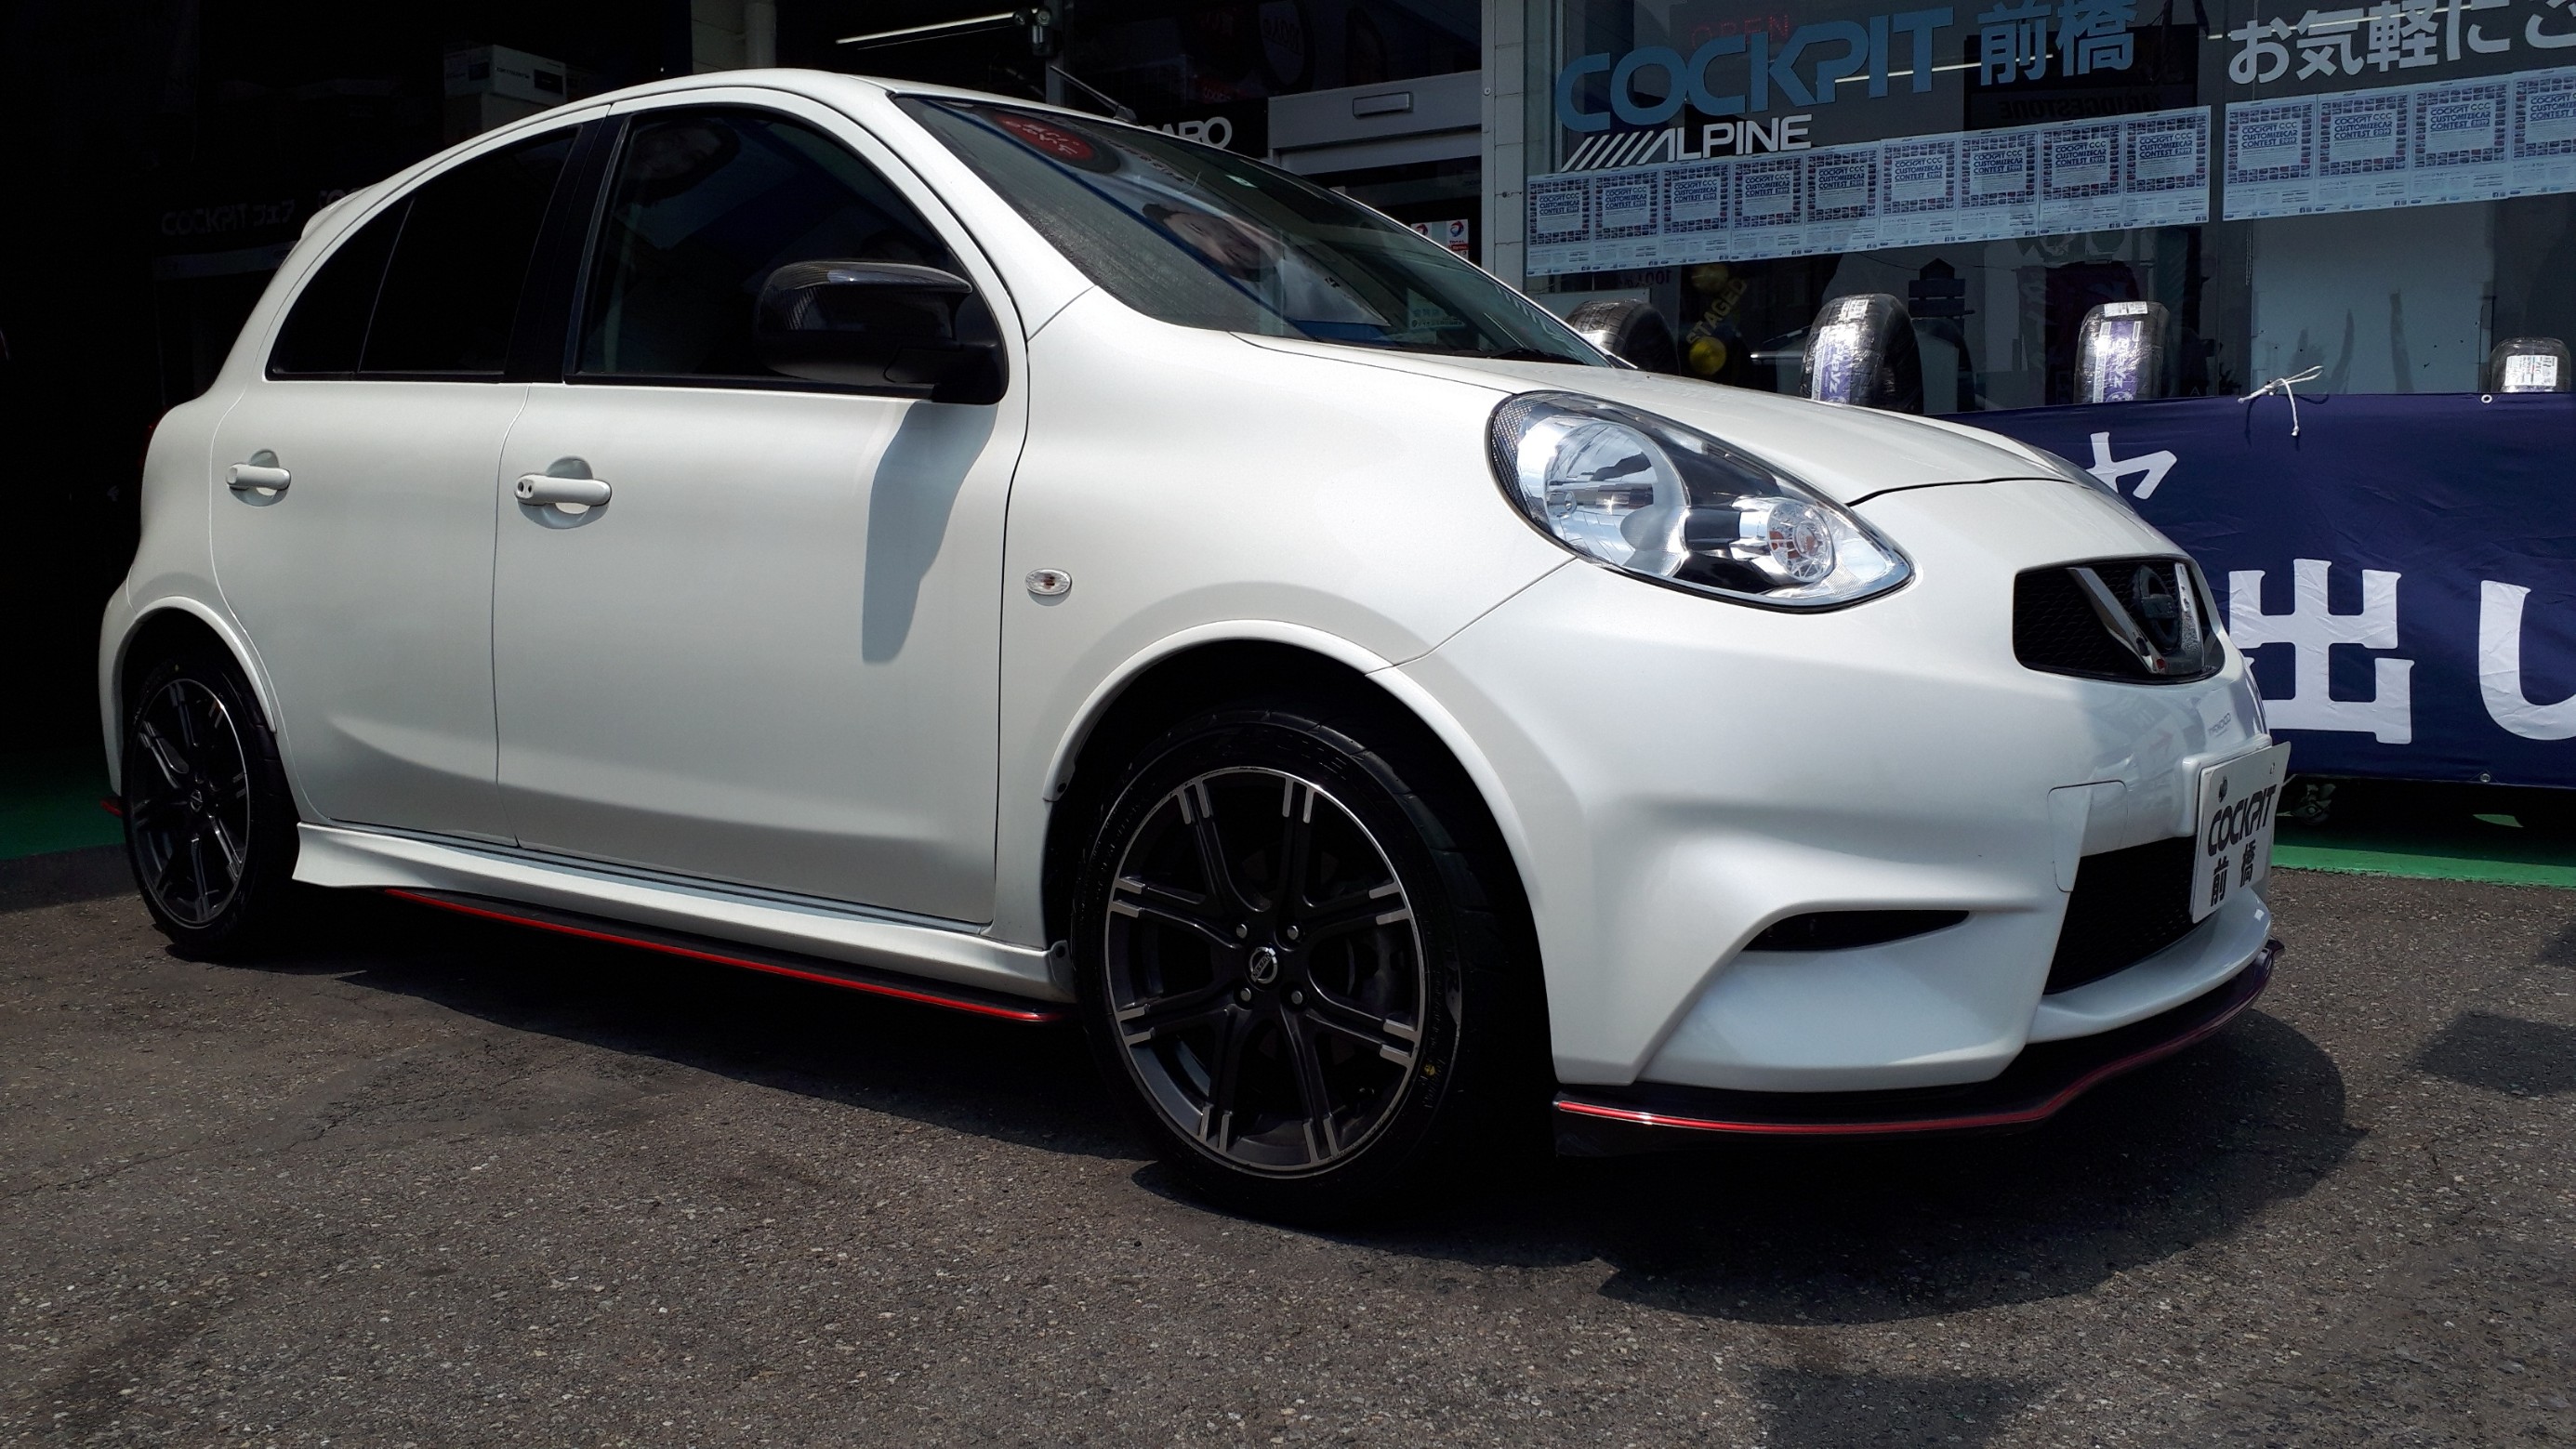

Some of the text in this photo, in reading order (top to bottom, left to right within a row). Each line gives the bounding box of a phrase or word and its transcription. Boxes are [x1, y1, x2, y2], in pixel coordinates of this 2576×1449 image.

[1556, 0, 2138, 132] COCKPIT 前橋
[1636, 113, 1813, 166] ALPINE
[2208, 784, 2277, 857] COCKPIT
[2211, 839, 2256, 907] 前橋
